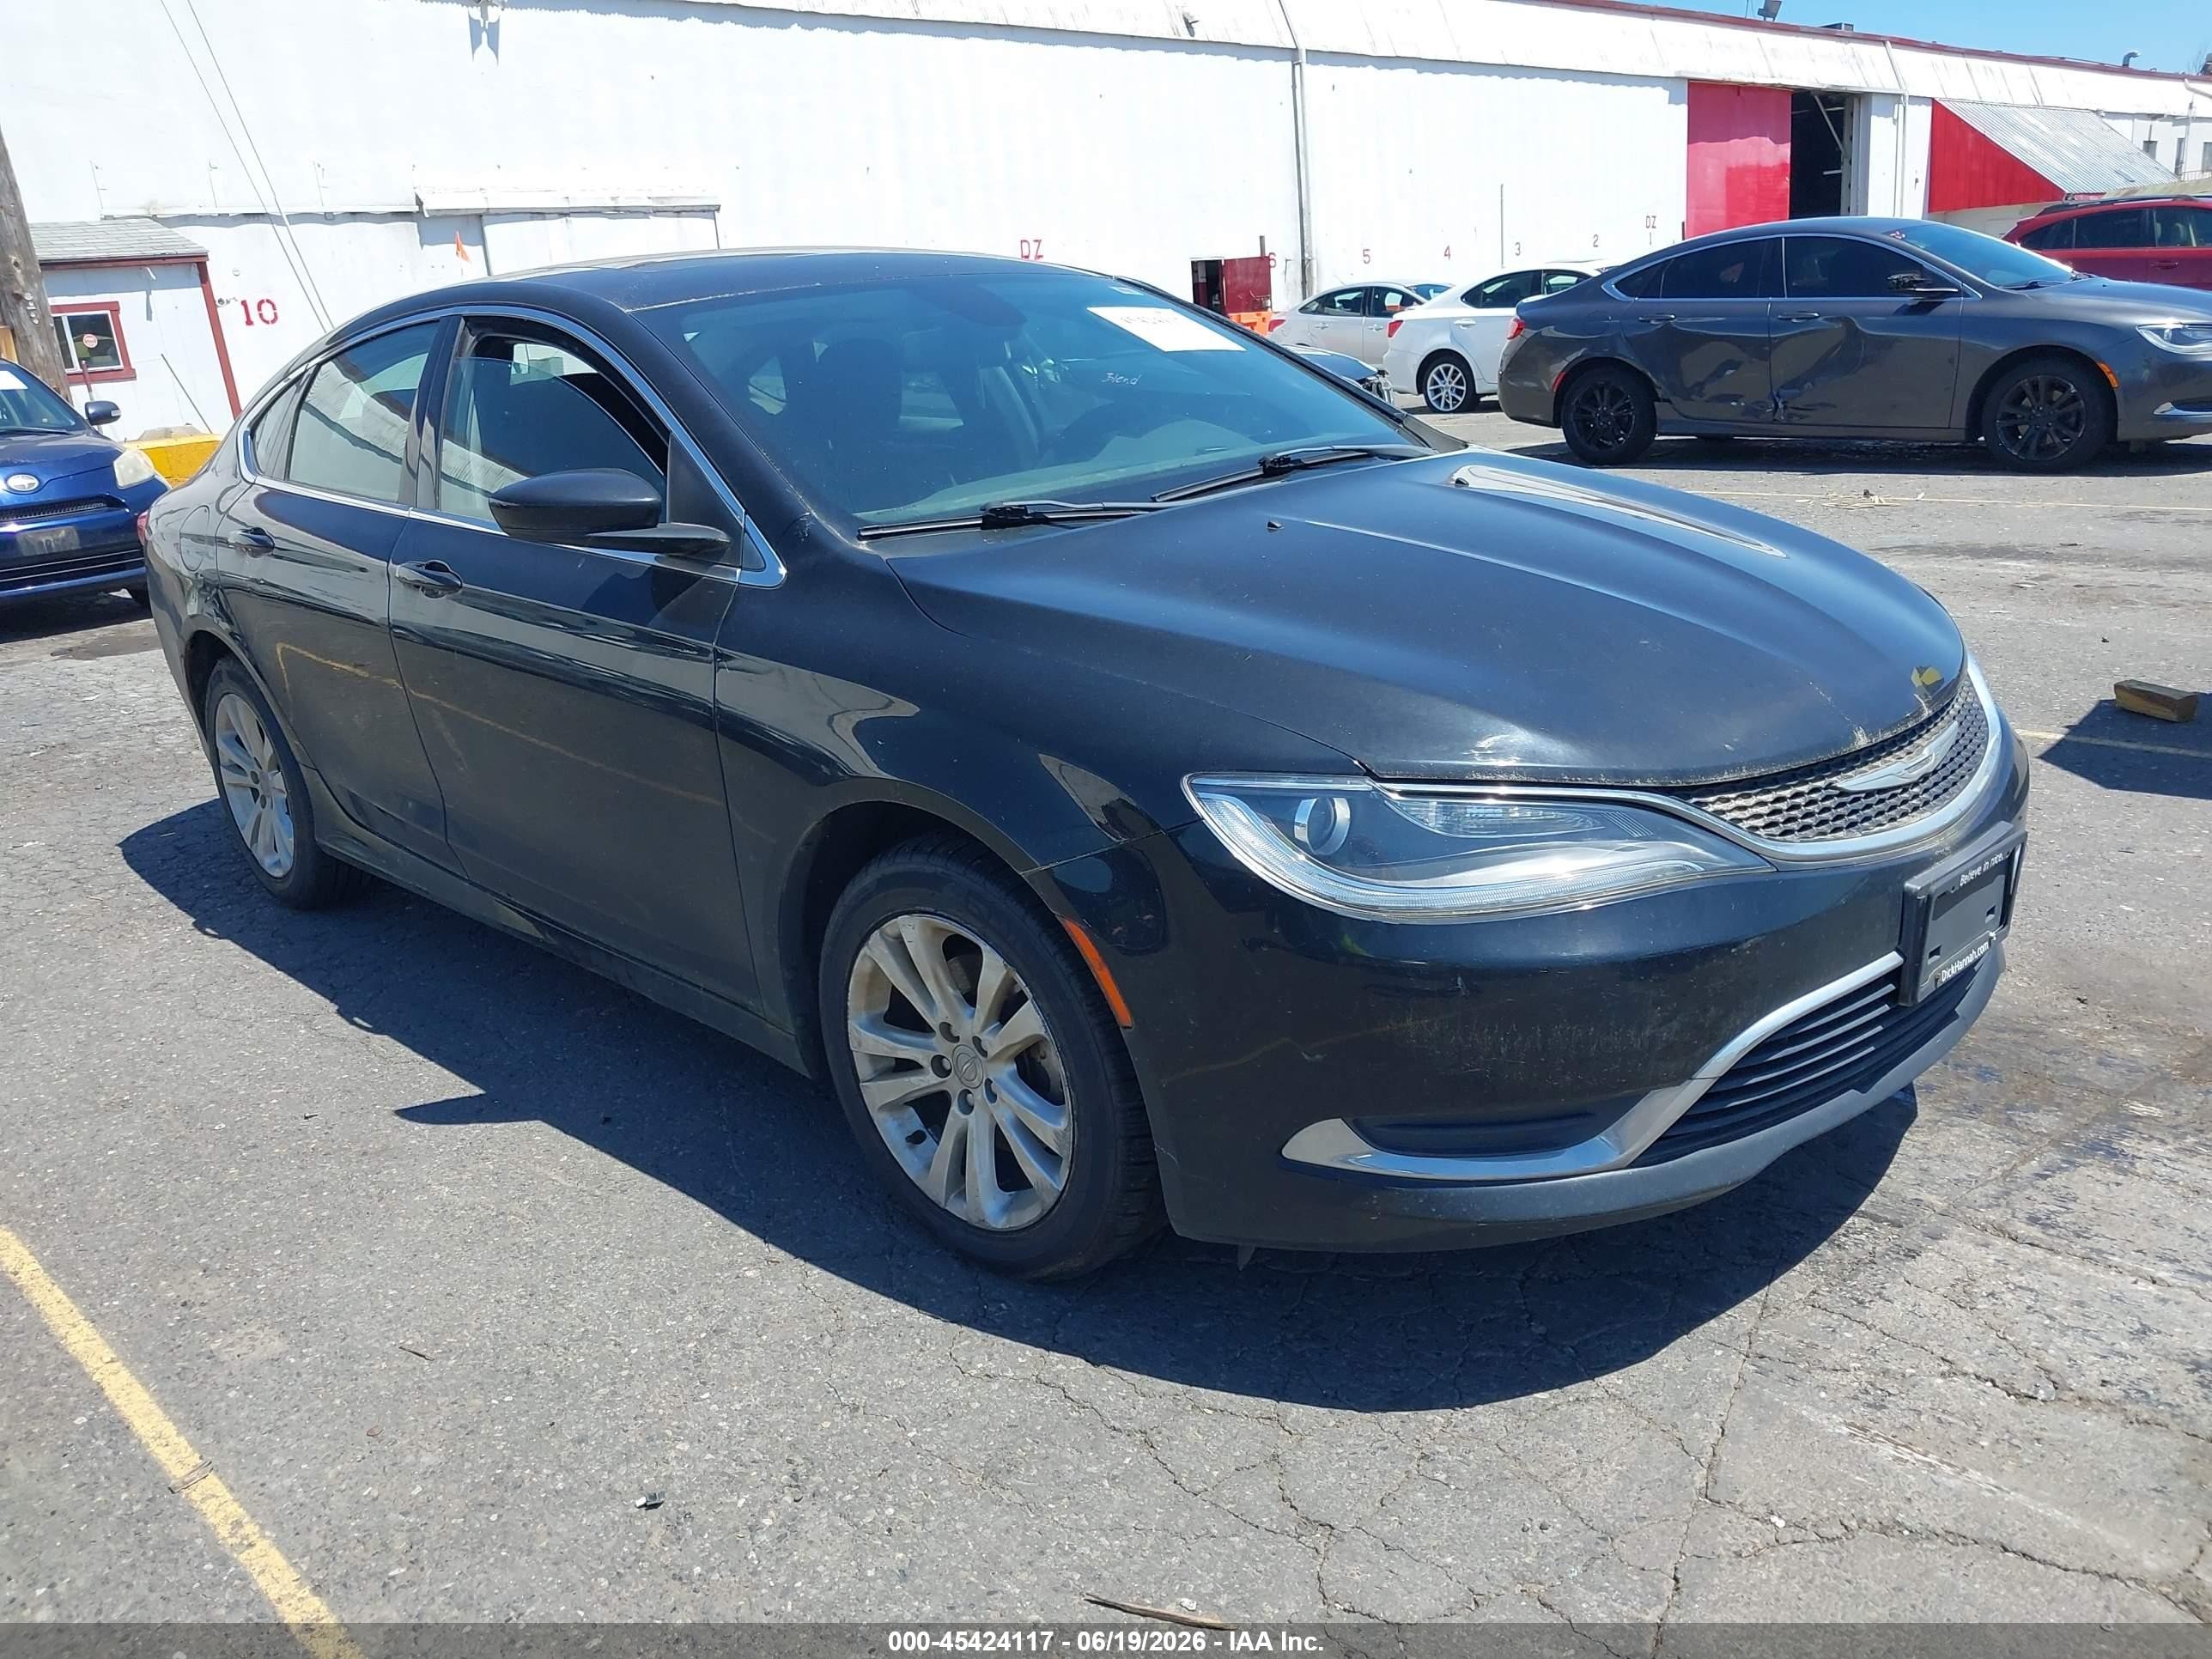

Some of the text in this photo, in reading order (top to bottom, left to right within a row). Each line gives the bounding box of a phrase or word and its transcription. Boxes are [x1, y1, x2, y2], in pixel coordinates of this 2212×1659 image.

[1645, 216, 1656, 229] DZ
[1593, 234, 1600, 247] 2
[1020, 239, 1044, 261] DZ
[1363, 248, 1371, 264] 5
[1443, 246, 1451, 260] 4
[1514, 242, 1522, 256] 3
[1268, 252, 1277, 269] 6
[240, 298, 278, 326] 10
[1960, 866, 1983, 887] Believe
[1983, 860, 1990, 872] in
[1941, 941, 1990, 982] DickHannah.com
